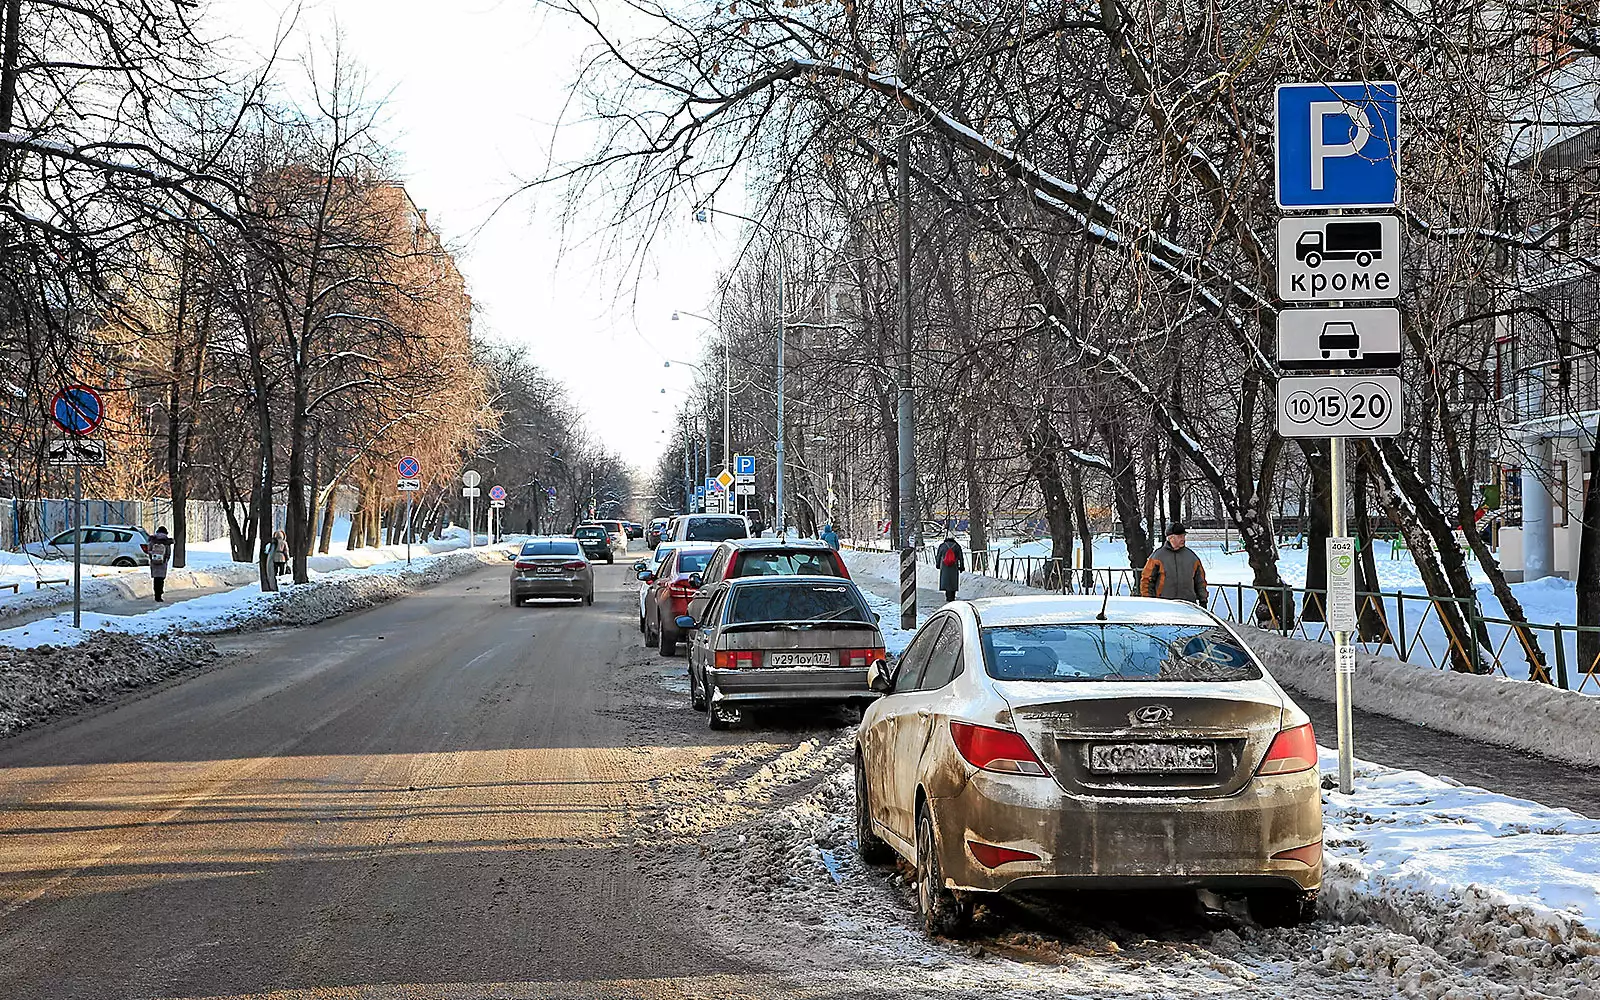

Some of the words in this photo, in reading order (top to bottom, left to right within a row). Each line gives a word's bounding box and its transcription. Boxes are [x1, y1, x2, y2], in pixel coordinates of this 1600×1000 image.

[1310, 101, 1370, 190] P
[1290, 270, 1391, 298] кроме
[1290, 398, 1311, 416] 10
[1317, 396, 1342, 417] 15
[1350, 393, 1386, 419] 20
[742, 458, 751, 472] P
[813, 653, 828, 664] 177
